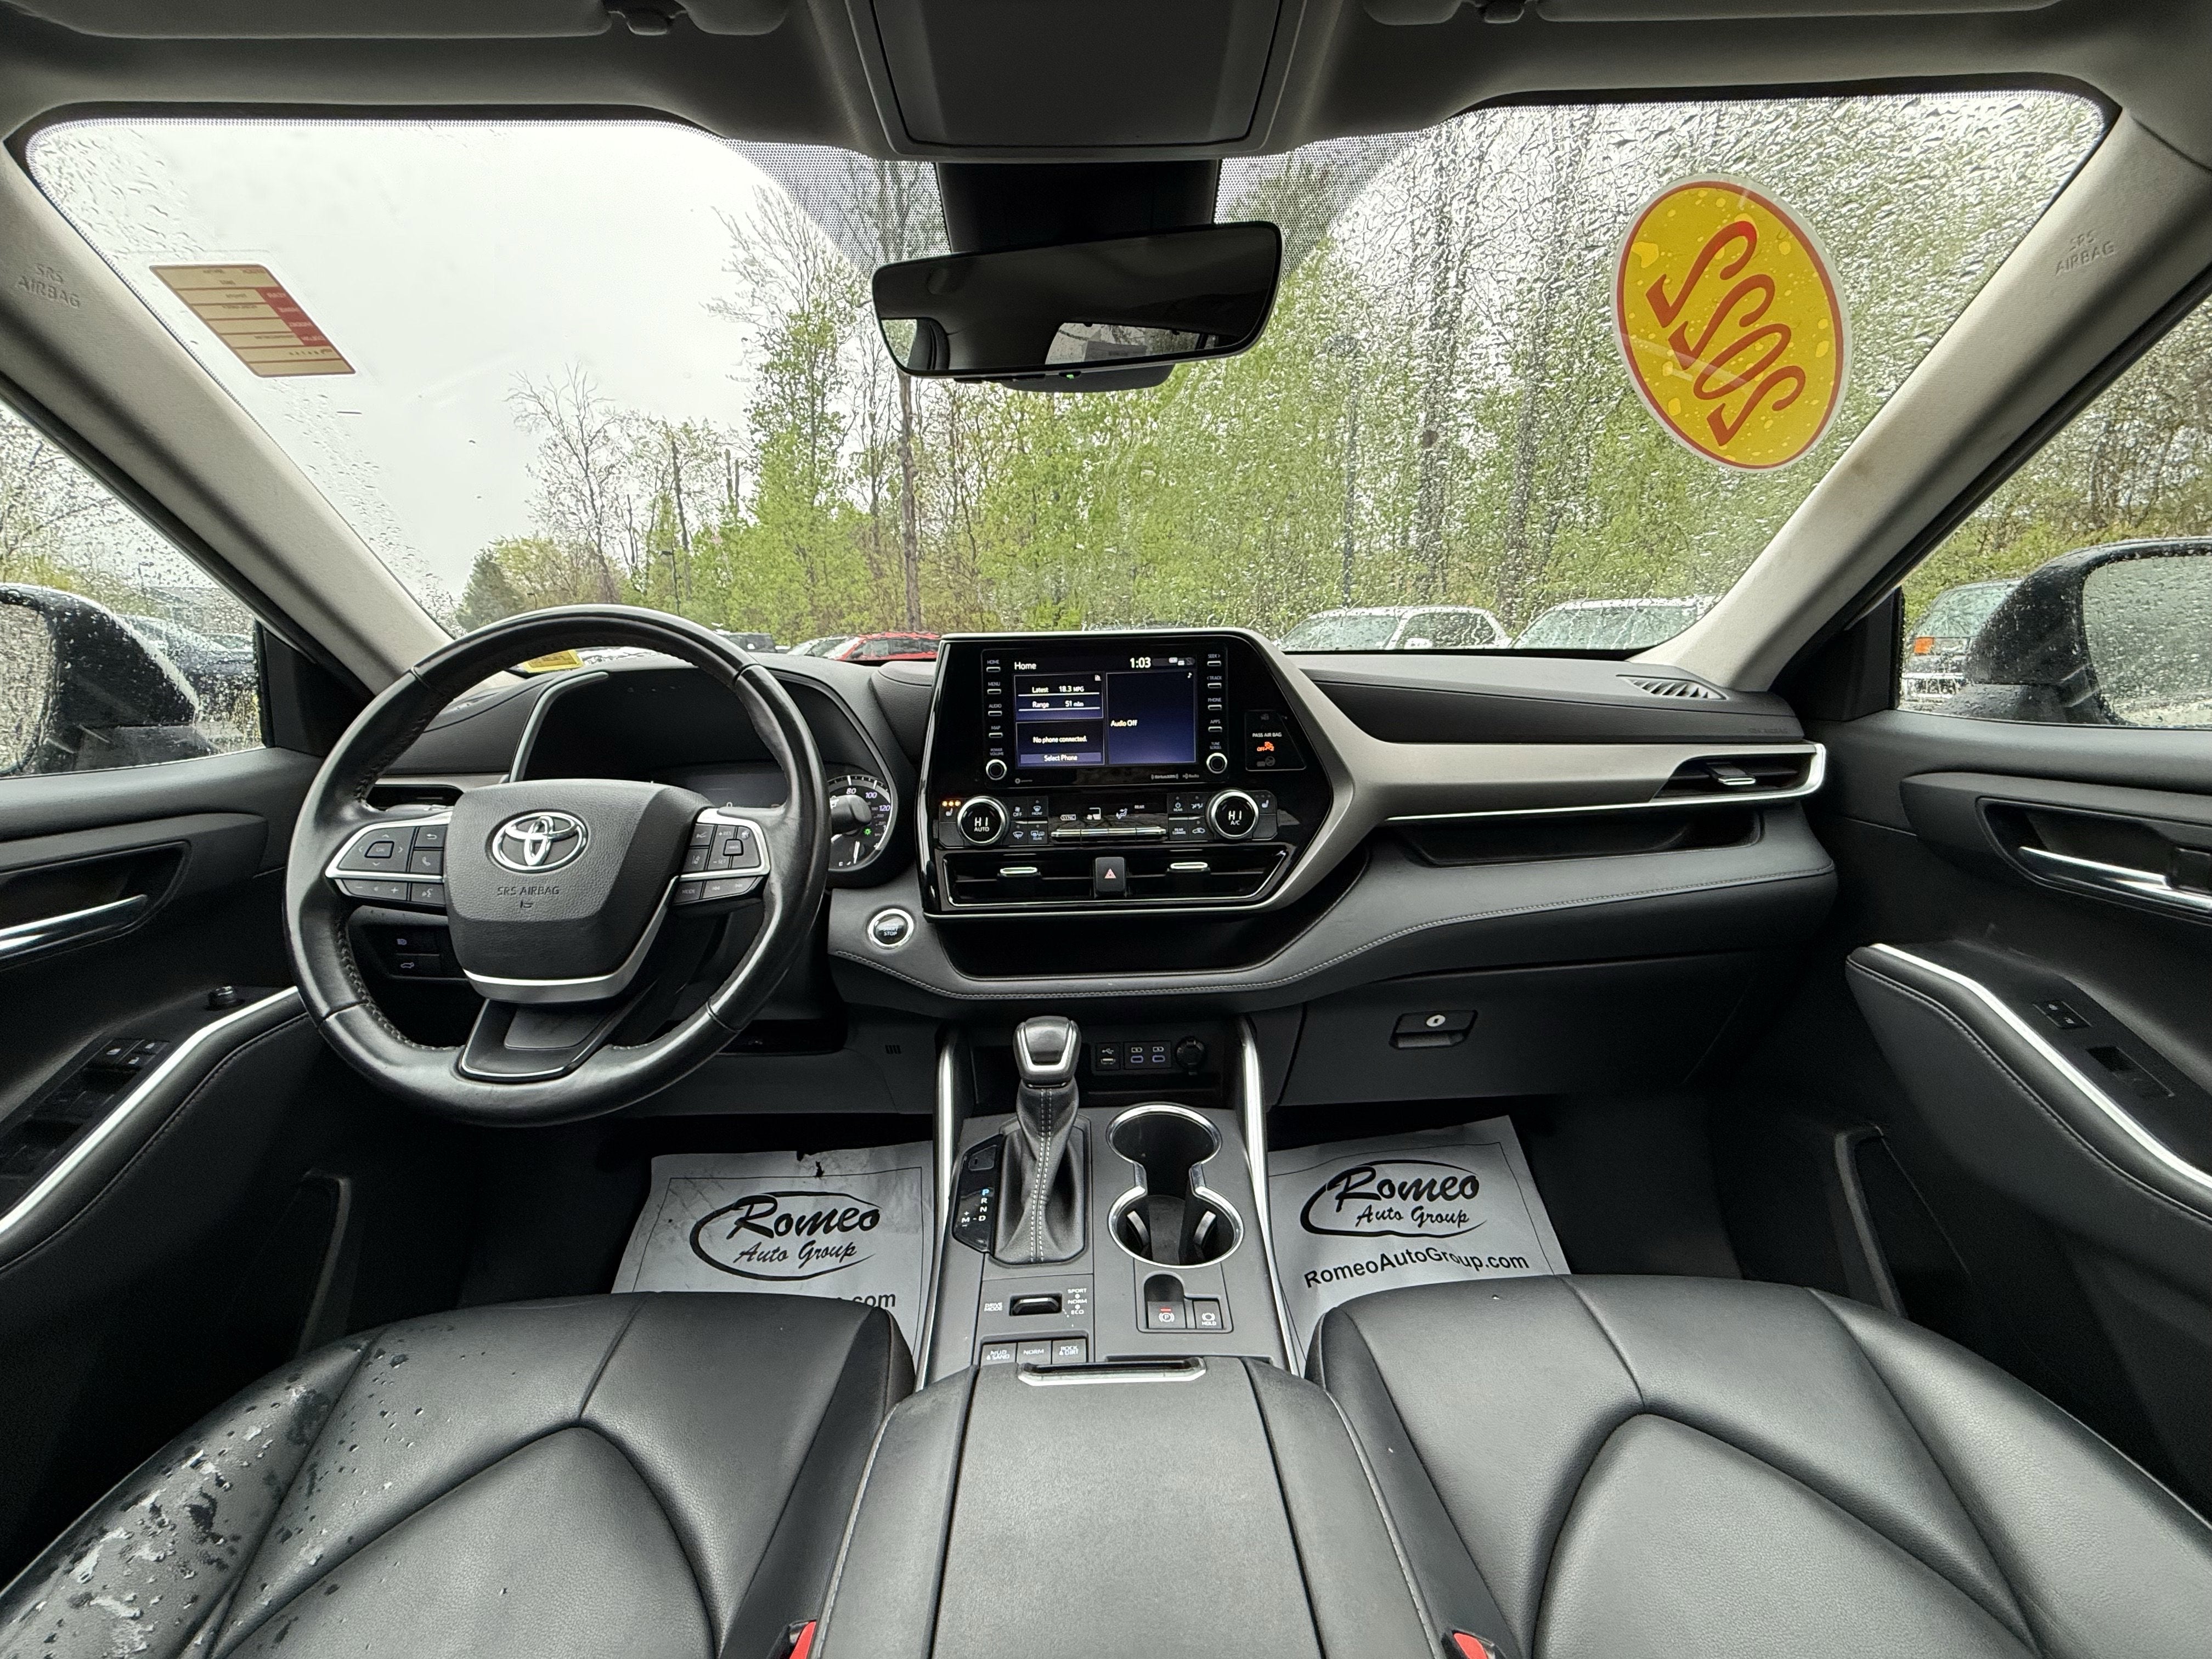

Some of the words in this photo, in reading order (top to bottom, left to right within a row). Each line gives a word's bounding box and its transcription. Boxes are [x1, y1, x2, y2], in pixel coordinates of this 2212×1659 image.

[2055, 240, 2114, 276] AIRBAG
[16, 275, 80, 308] AIRBAG
[1014, 662, 1037, 670] Home
[1130, 657, 1151, 668] 1:03
[497, 887, 516, 895] SRS
[520, 886, 560, 895] AIRBAG
[1328, 1166, 1480, 1211] Romeo
[727, 1195, 881, 1239] Romeo
[1355, 1205, 1403, 1227] Auto
[1411, 1205, 1470, 1228] Group
[733, 1242, 788, 1263] Auto
[798, 1239, 857, 1269] Group
[1304, 1247, 1530, 1288] RomeoAutoGroup.com
